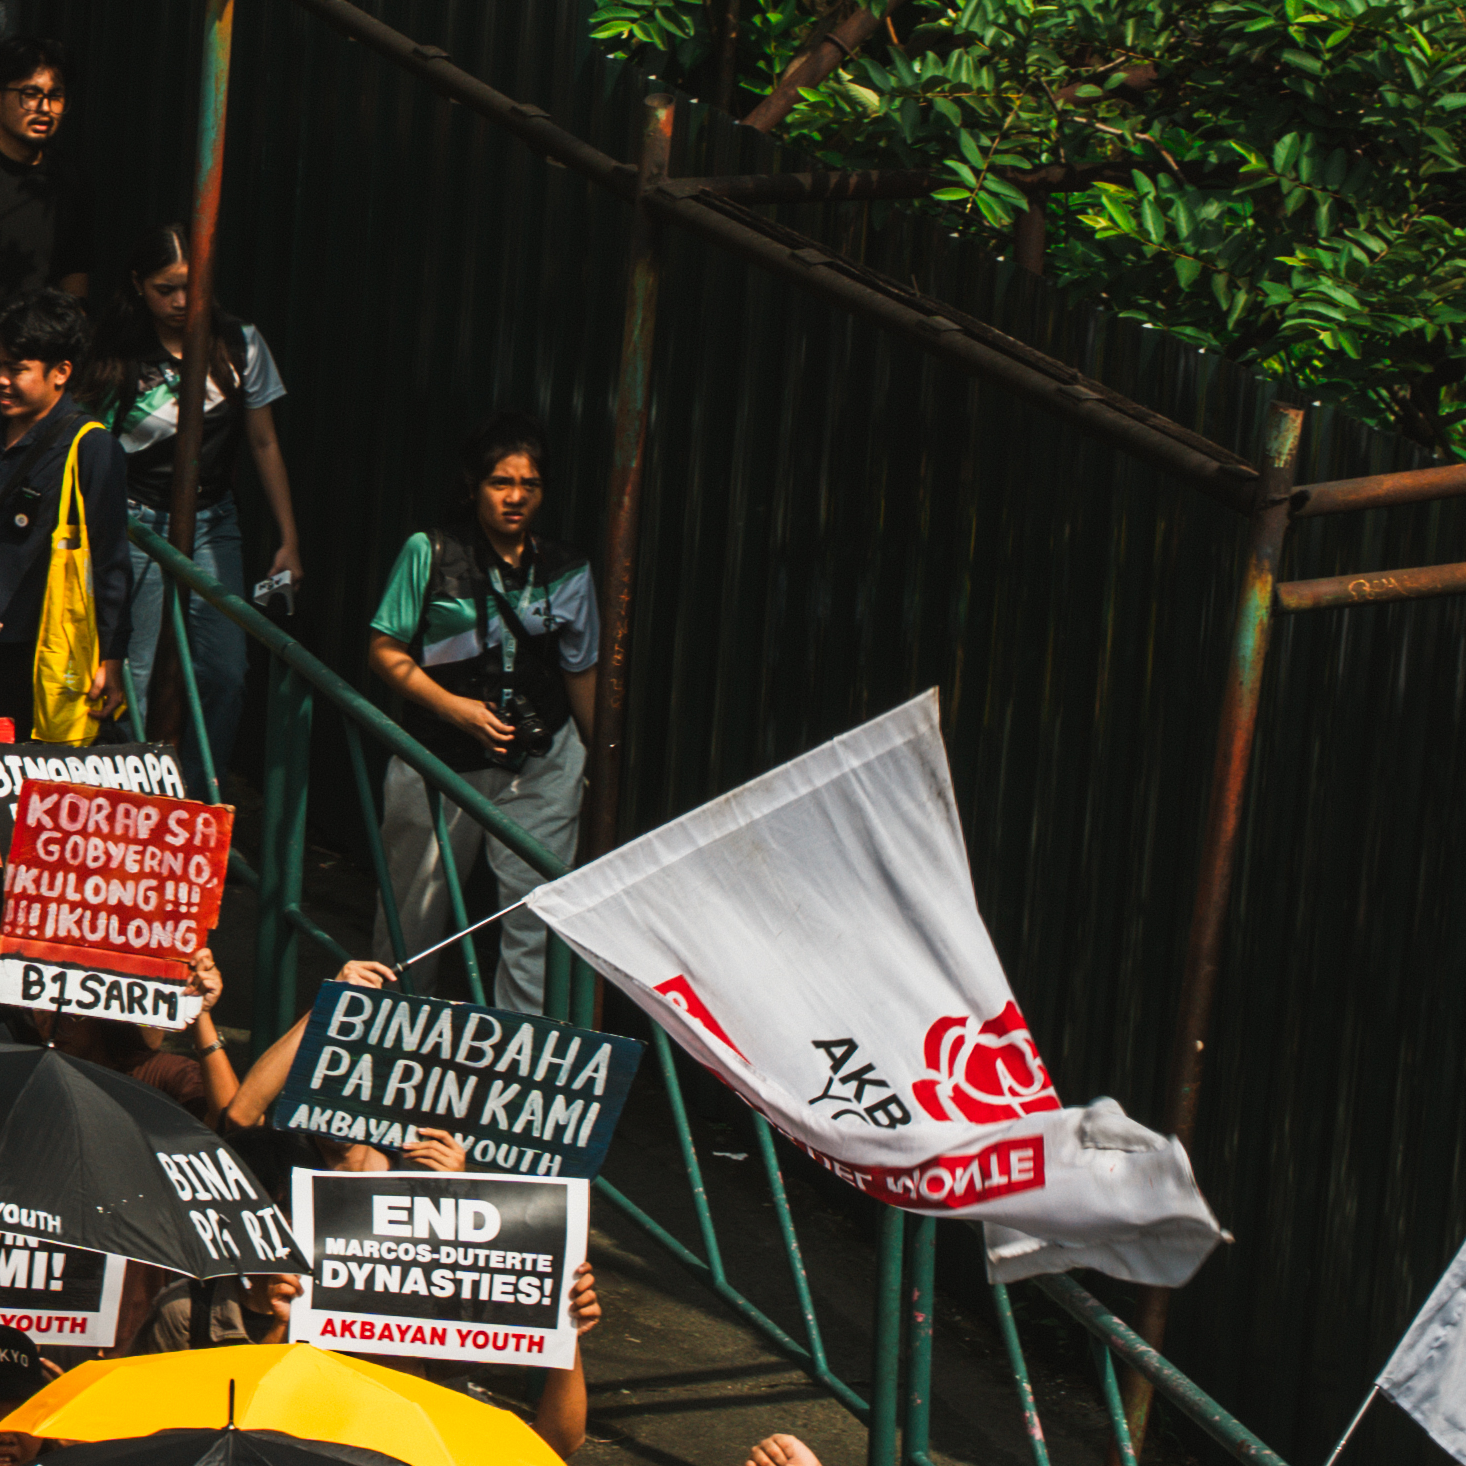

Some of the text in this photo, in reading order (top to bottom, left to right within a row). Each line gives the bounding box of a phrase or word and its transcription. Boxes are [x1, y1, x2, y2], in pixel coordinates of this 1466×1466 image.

[26, 792, 218, 849] KORAP SA
[324, 990, 614, 1098] BINABAHA
[309, 1045, 605, 1148] PA RIN KAMI
[155, 1146, 260, 1204] BINA
[466, 1133, 563, 1177] YOUTH
[371, 1192, 503, 1243] END
[324, 1235, 555, 1276] MARCOS-DUTERTE
[320, 1256, 555, 1308] DYNASTIES!
[2, 1309, 89, 1337] YOUTH
[320, 1317, 547, 1356] AKBAYAN YOUTH
